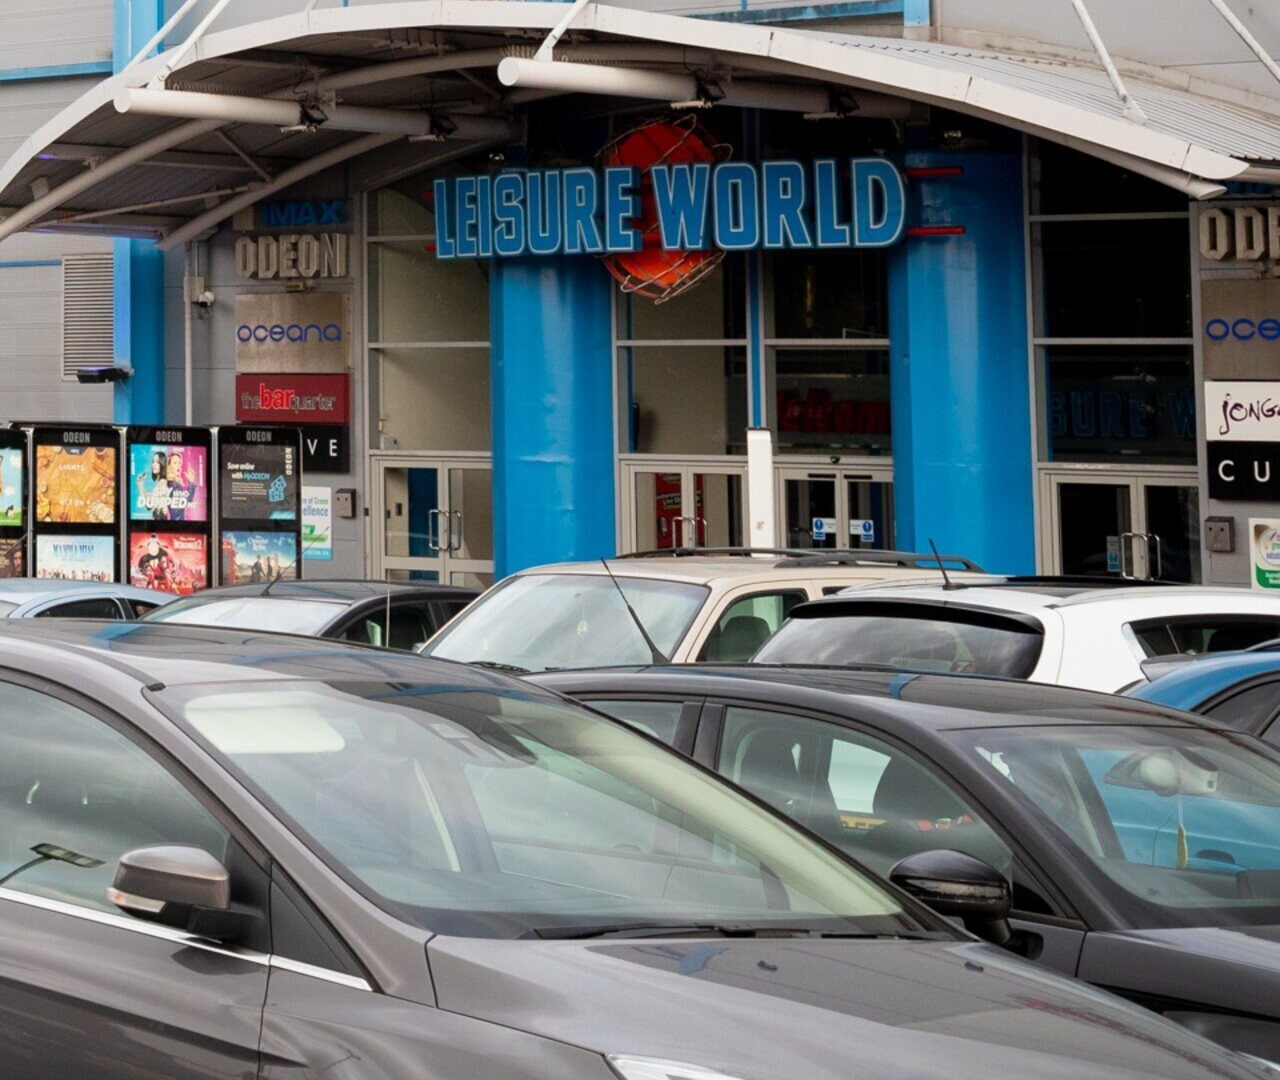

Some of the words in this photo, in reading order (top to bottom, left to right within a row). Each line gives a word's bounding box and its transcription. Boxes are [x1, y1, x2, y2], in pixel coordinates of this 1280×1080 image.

[262, 201, 343, 226] IMAX
[434, 168, 637, 259] LEISURE
[651, 157, 907, 252] WORLD
[235, 233, 348, 279] ODEON
[237, 324, 342, 342] oceana
[63, 432, 90, 443] ODEON
[155, 430, 182, 442] ODEON
[246, 431, 272, 442] ODEON
[137, 497, 187, 509] DUMPED
